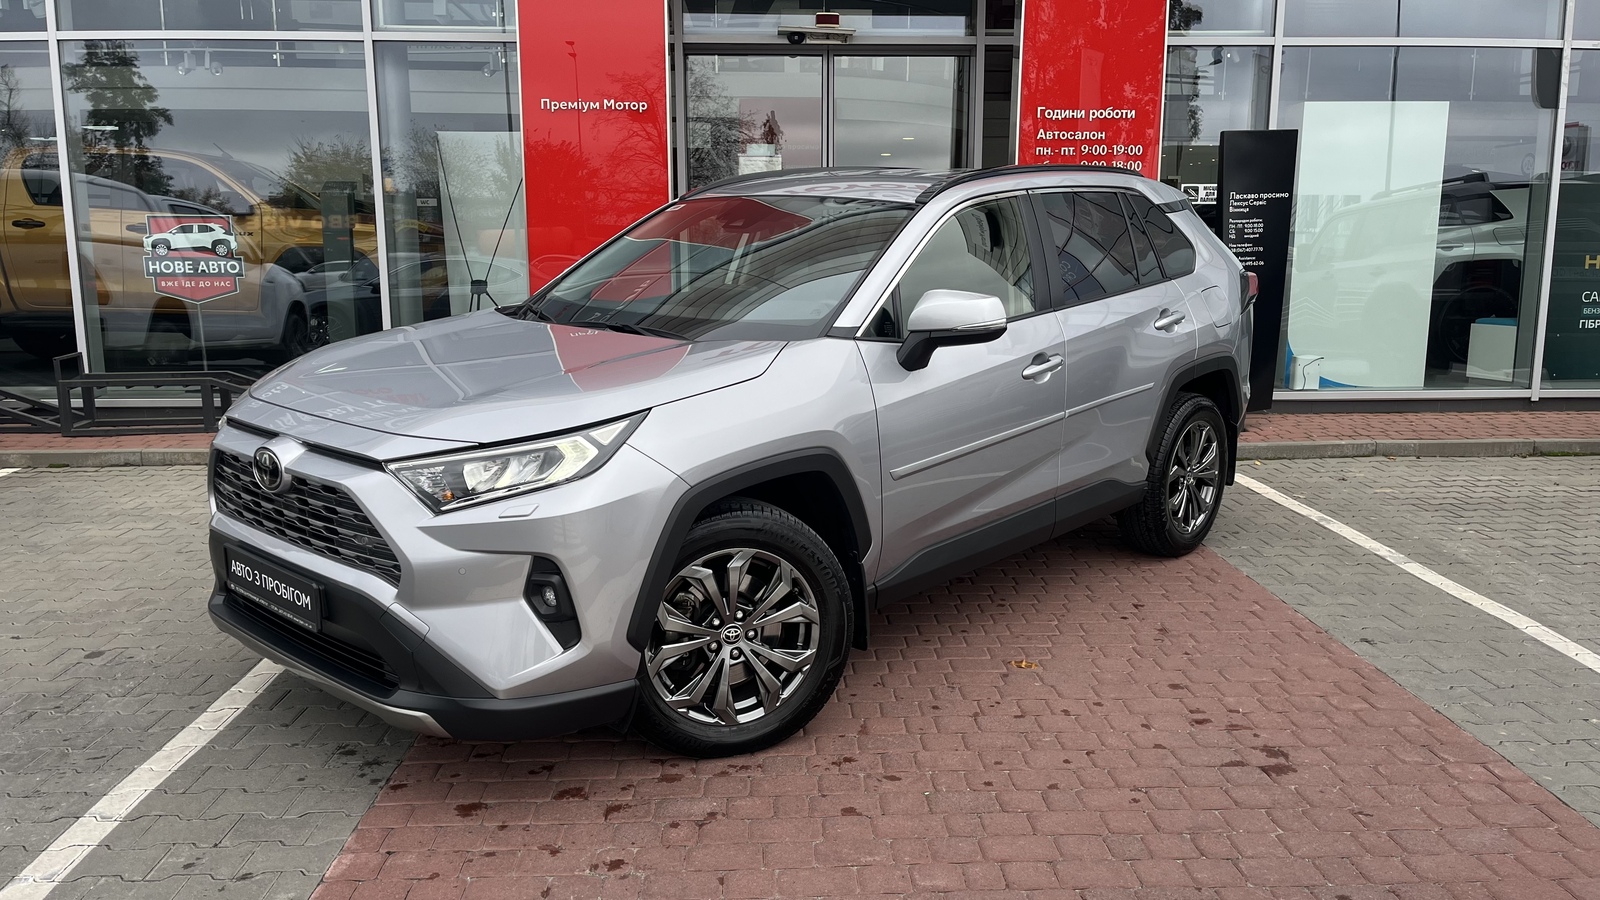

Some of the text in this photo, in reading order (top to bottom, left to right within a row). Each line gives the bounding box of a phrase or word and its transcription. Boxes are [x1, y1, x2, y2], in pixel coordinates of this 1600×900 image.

[540, 98, 648, 113] Преміум Мотор
[1037, 106, 1136, 121] Години роботи
[1036, 128, 1105, 140] Автосалон
[1080, 144, 1143, 156] 9:00-19:00
[1229, 191, 1289, 200] Ласкаво просимо
[148, 260, 240, 274] НОВЕ АВТО
[181, 280, 196, 288] ЇДЕ
[198, 280, 212, 288] ДО
[231, 559, 253, 581] АВТО
[253, 570, 261, 586] З
[261, 573, 312, 611] ПРОБІГОМ
